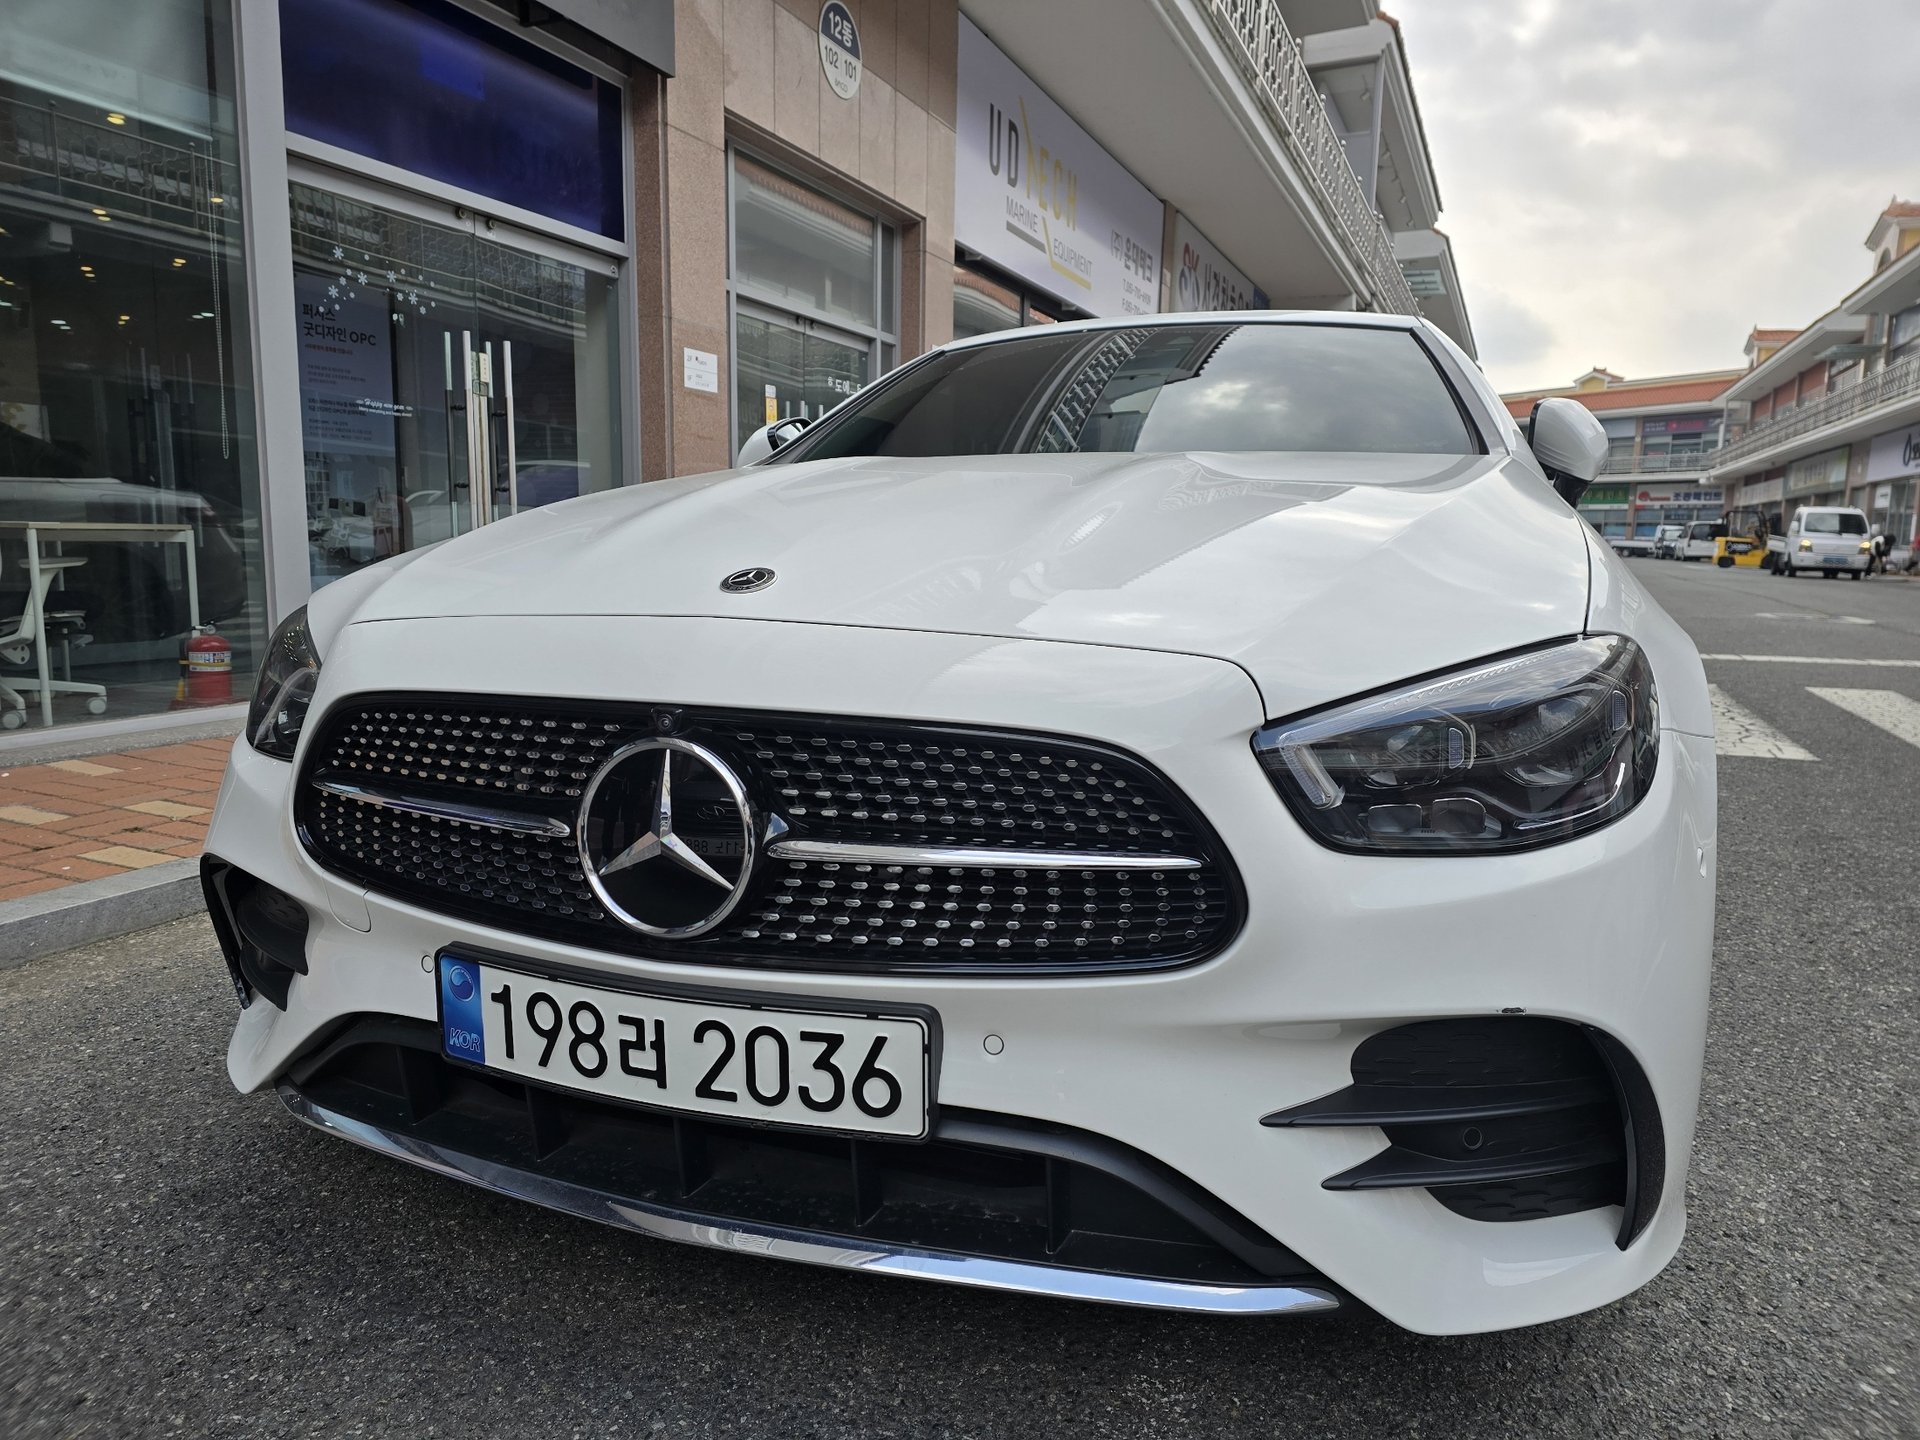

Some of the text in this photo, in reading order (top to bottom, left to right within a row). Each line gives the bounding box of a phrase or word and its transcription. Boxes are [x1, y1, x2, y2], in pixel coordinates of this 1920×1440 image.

[828, 10, 853, 48] 12동
[824, 44, 857, 82] 102 101
[1006, 195, 1038, 234] MARINE
[1053, 237, 1093, 277] EQUIPMENT
[303, 321, 377, 346] 굿디자인 OPC
[364, 398, 383, 409] Happy
[448, 1026, 482, 1054] KOR
[490, 983, 903, 1120] 198러 2036
